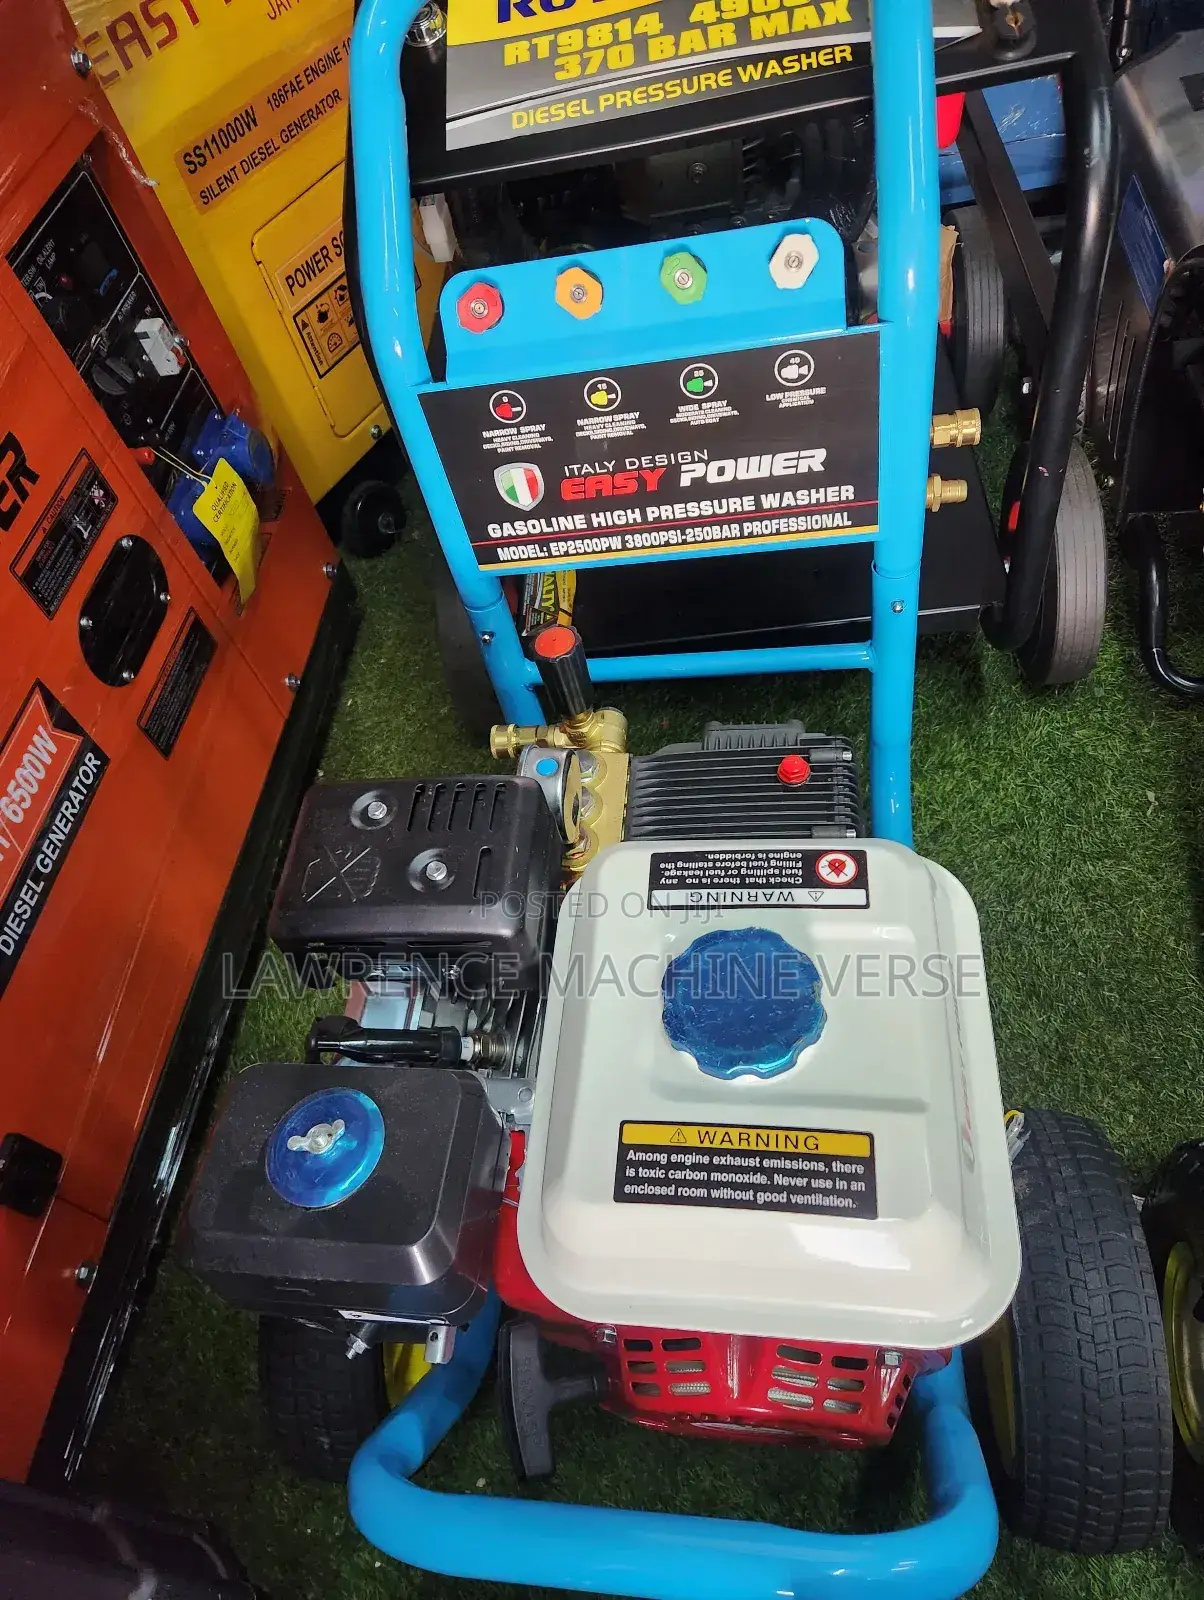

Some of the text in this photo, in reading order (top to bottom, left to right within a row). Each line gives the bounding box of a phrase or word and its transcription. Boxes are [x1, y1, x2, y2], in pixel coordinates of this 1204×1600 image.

[504, 12, 664, 66] RT9814
[554, 0, 852, 81] 370 BAR MAX
[512, 45, 853, 130] DIESEL PRESSURE WASHER
[183, 105, 258, 175] SS11000W
[267, 74, 305, 112] 186FAE
[304, 46, 343, 85] ENGINE
[200, 88, 342, 205] SILENT DIESEL GENERATOR
[285, 245, 333, 296] POWER
[305, 331, 324, 366] Attention
[790, 356, 801, 364] 40
[766, 387, 827, 401] LOW PRESSURE
[678, 399, 728, 413] WIDE SPRAY
[576, 411, 640, 427] NARROW SPRAY
[604, 419, 636, 428] CLEANING
[482, 423, 546, 439] NARROW SPRAY
[511, 432, 540, 441] CLEANING
[560, 447, 827, 501] EASY POWER
[564, 449, 709, 477] ITALY DESIGN
[211, 481, 229, 511] QUALIFIED
[46, 495, 66, 527] CAUTION
[487, 484, 855, 539] GASOLINE HIGH PRESSURE WASHER
[497, 511, 852, 563] MODEL: EP2500PW 3800PSI-250BAR PROFESSIONAL
[0, 752, 101, 956] DIESEL GENERATOR
[659, 860, 802, 869] Filling fuel before stalling the
[705, 852, 756, 861] forbidden.
[766, 852, 802, 860] engine
[659, 877, 679, 885] any
[661, 868, 803, 877] fuel spilling or fuel leakage.
[712, 876, 741, 884] there
[744, 876, 766, 884] that
[766, 876, 803, 884] Check
[689, 890, 796, 903] WARNING
[697, 1130, 820, 1151] WARNING
[626, 1149, 865, 1175] Among engine exhaust emissions, there
[625, 1165, 866, 1192] is toxic carbon monoxide. Never use in an
[624, 1182, 858, 1209] enclosed room without good ventilation.
